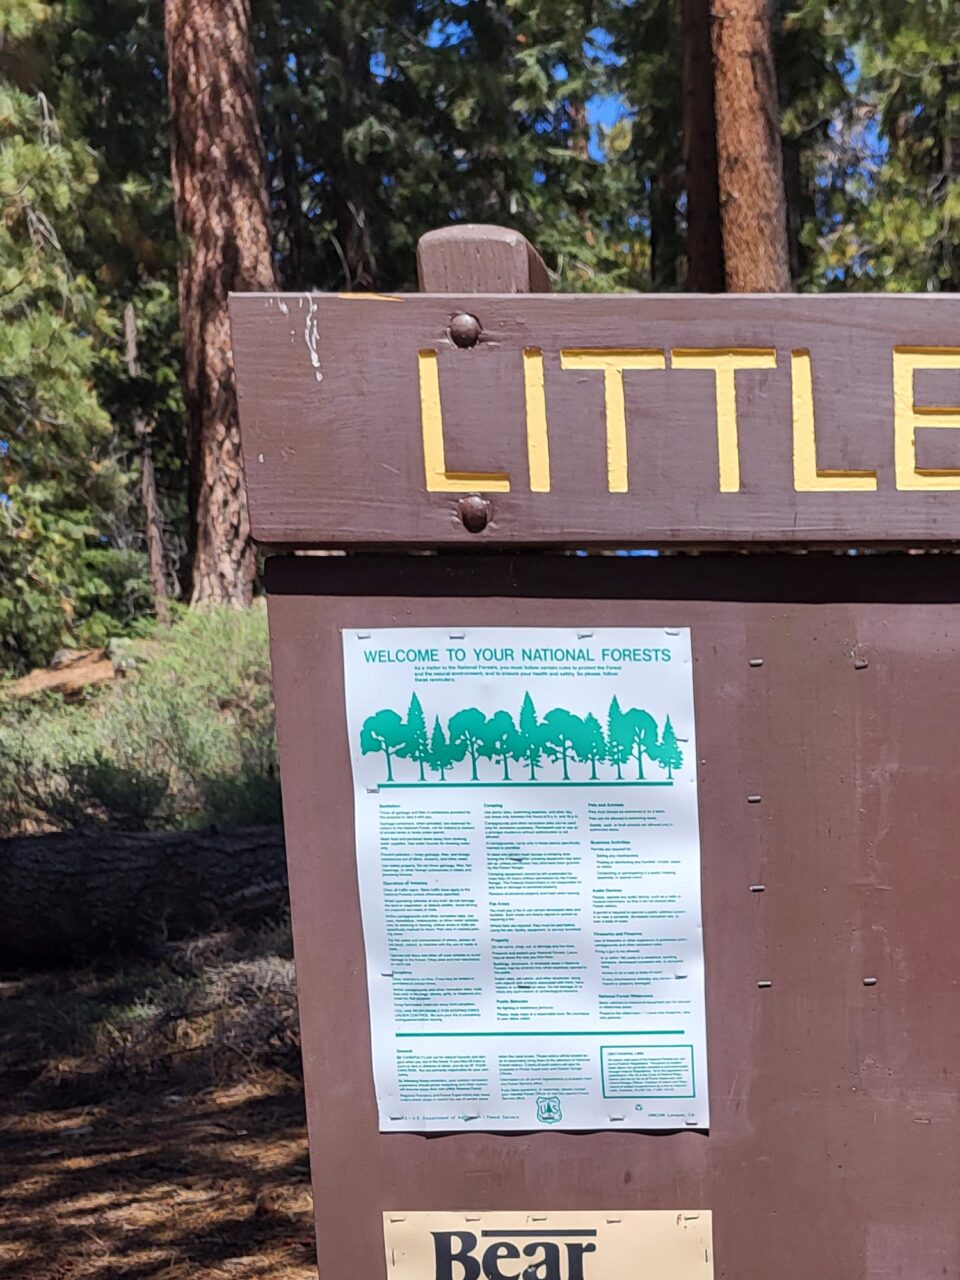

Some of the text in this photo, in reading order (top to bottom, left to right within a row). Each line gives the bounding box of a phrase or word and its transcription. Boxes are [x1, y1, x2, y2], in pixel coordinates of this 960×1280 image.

[364, 648, 671, 663] WELCOME TO YOUR NATIONAL FORESTS
